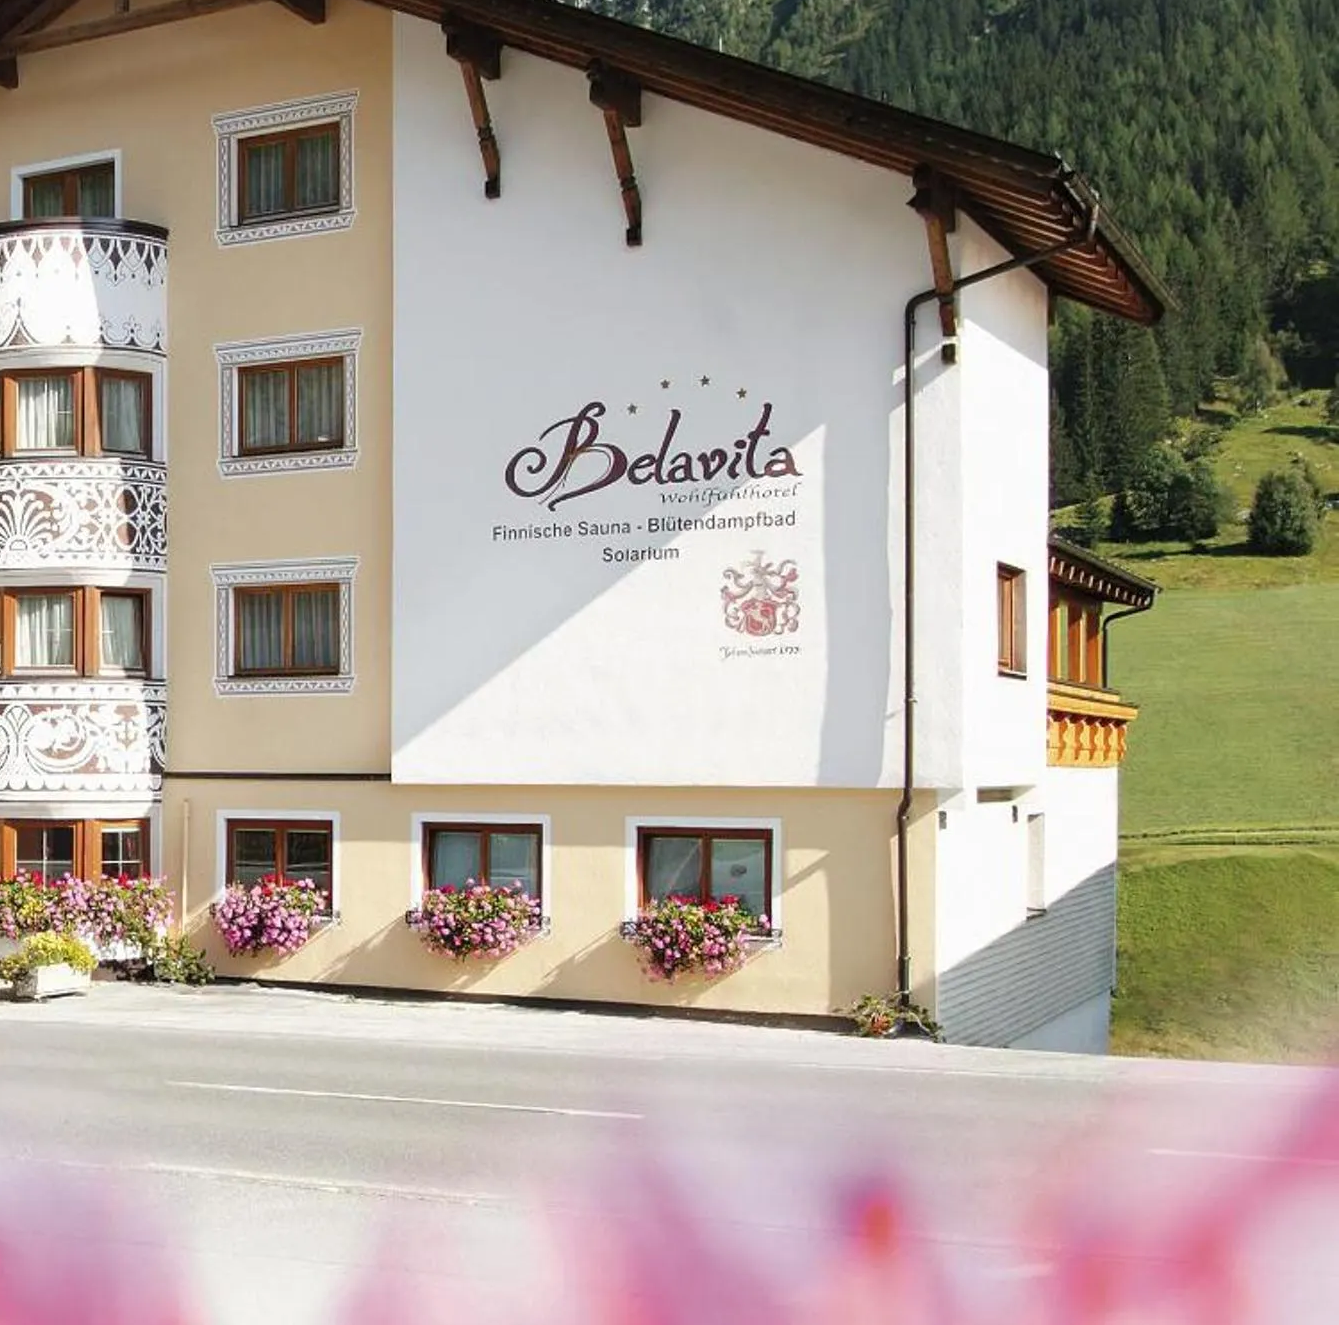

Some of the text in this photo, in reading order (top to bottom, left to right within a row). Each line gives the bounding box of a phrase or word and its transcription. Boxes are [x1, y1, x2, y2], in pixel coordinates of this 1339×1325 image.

[505, 401, 804, 512] Belavita
[492, 525, 573, 541] Finnische
[578, 520, 632, 537] Sauna
[647, 511, 797, 534] Blütendampfbad
[602, 546, 680, 563] Solarium
